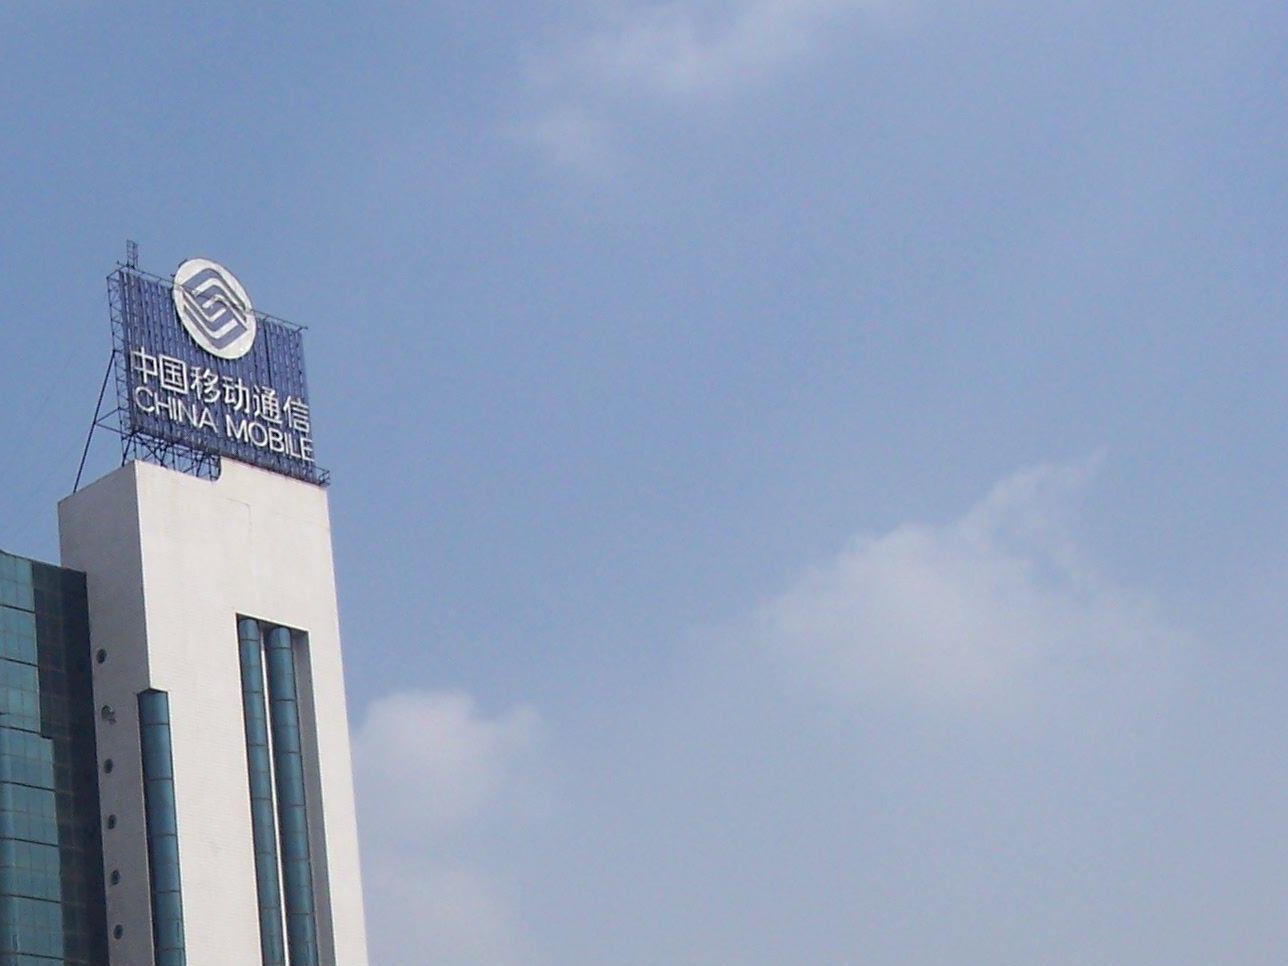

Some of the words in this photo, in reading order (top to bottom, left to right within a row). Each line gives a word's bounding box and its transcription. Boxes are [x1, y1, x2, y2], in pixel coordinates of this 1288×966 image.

[130, 347, 311, 433] 中国移动通信
[134, 386, 219, 434] CHINA
[225, 415, 316, 462] MOBILE
